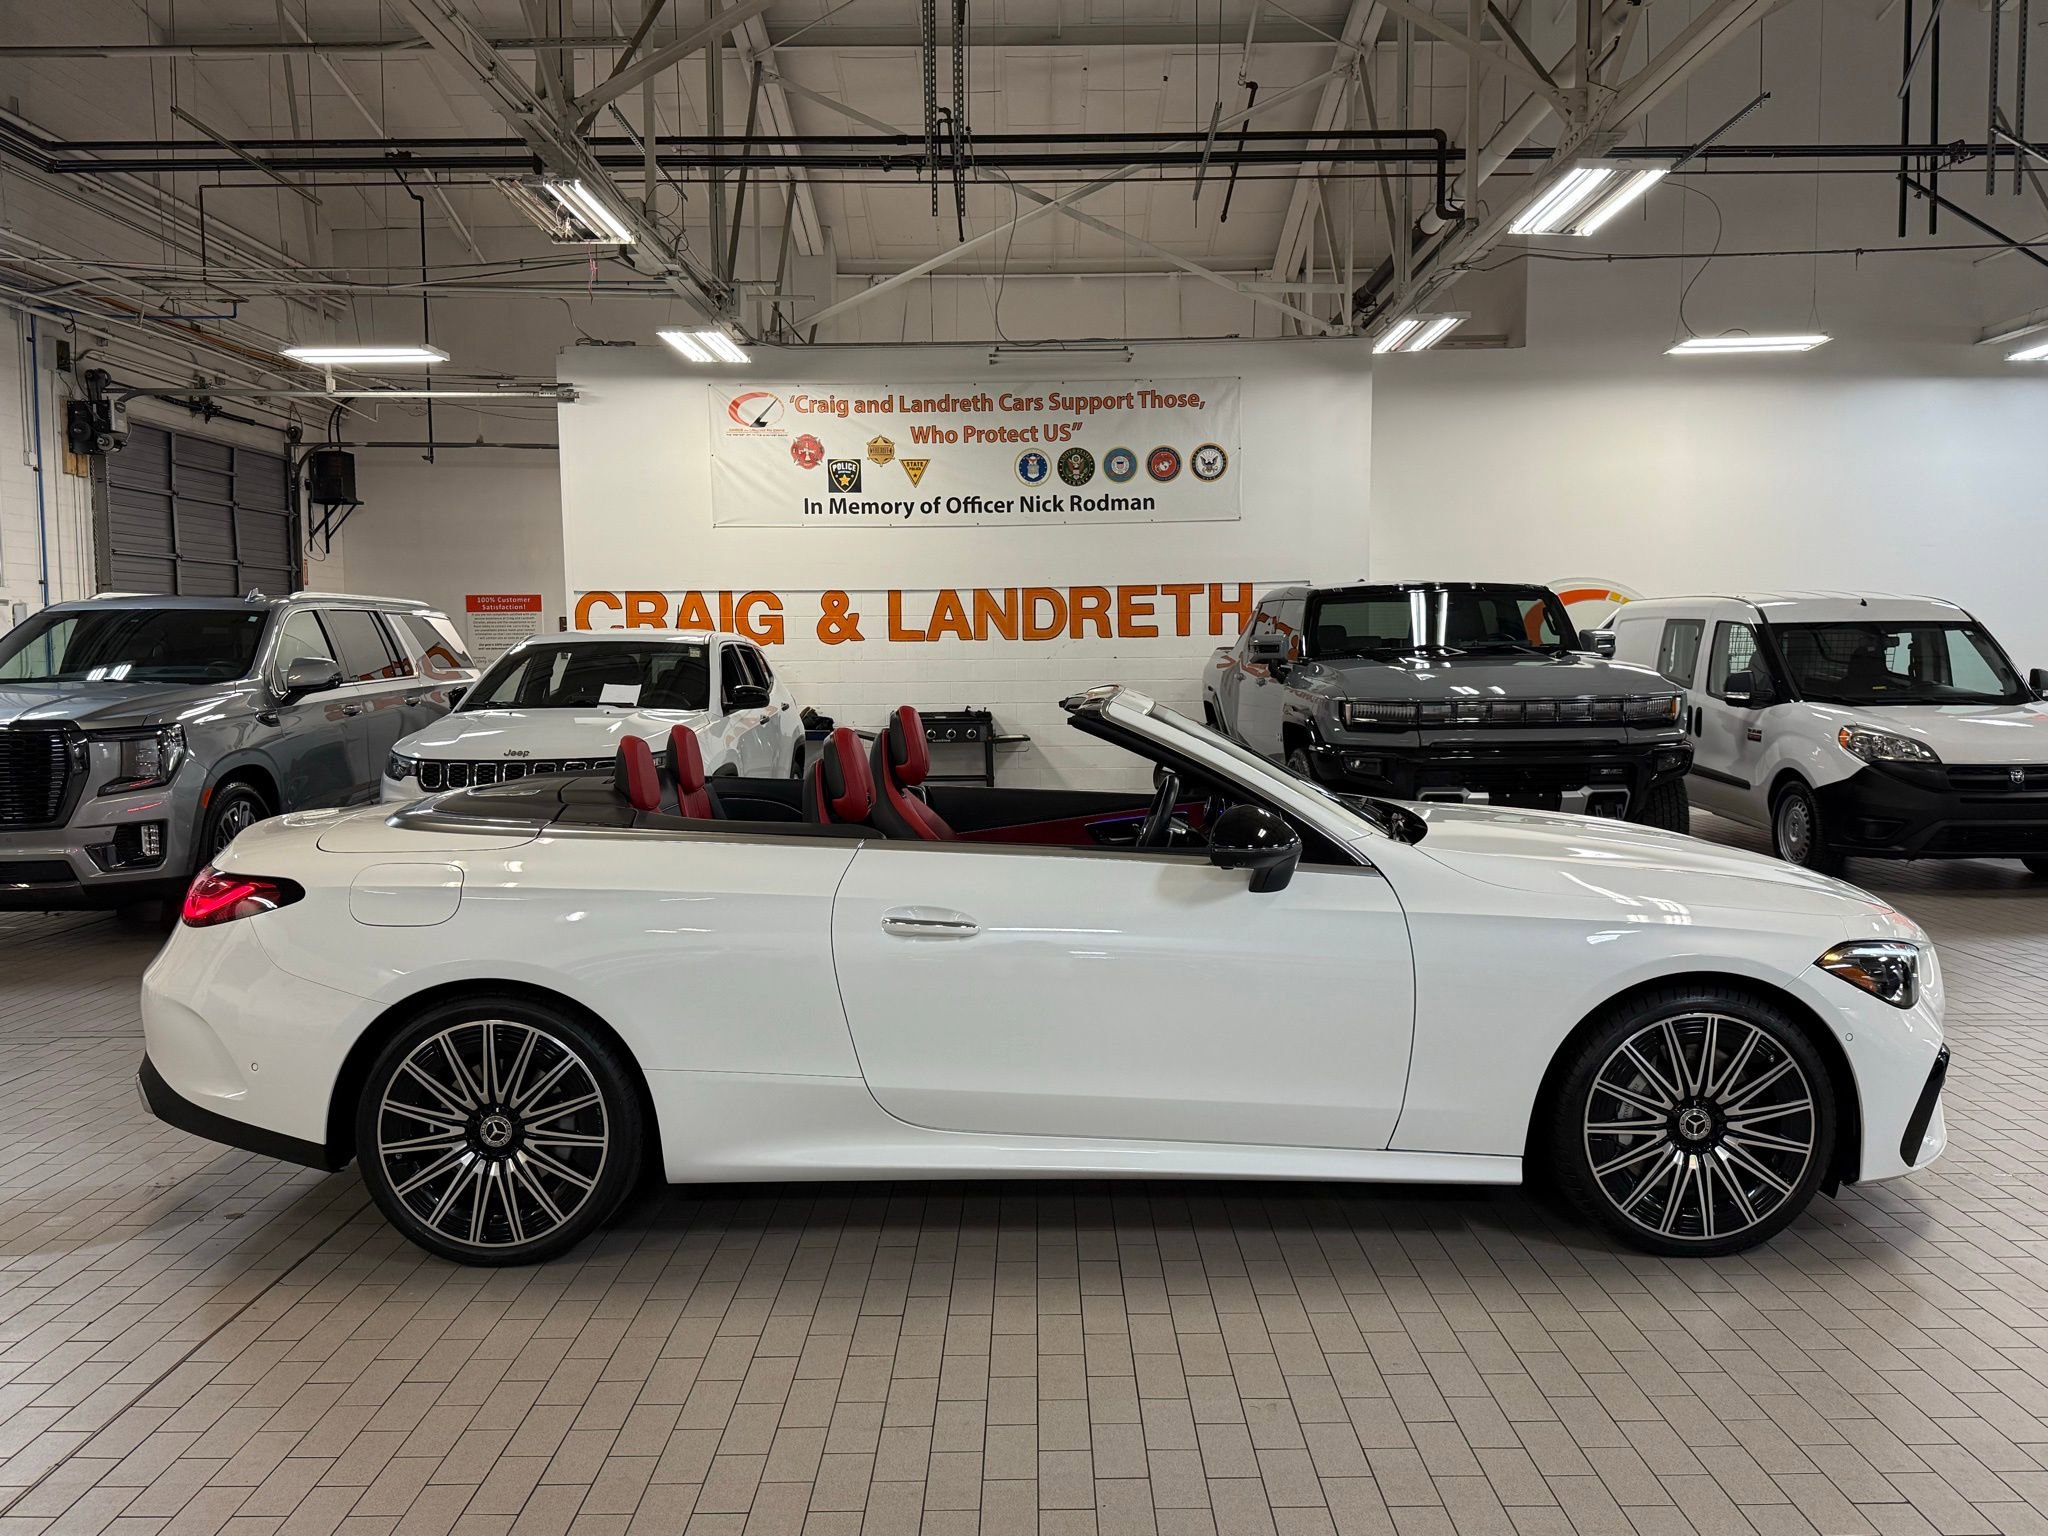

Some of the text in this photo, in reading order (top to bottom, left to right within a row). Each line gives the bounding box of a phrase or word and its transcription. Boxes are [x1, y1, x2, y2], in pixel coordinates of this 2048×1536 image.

[854, 395, 894, 413] and
[899, 393, 994, 413] Landreth
[998, 393, 1044, 412] Cars
[1048, 392, 1134, 415] Support
[1137, 389, 1206, 410] Those,
[910, 421, 1083, 444] Who Protect US"
[832, 461, 857, 472] POLICE
[804, 493, 1155, 519] In Memory of Officer Nick Rodman
[575, 583, 1253, 646] CRAIG & LANDRETH
[503, 749, 531, 758] Jeep
